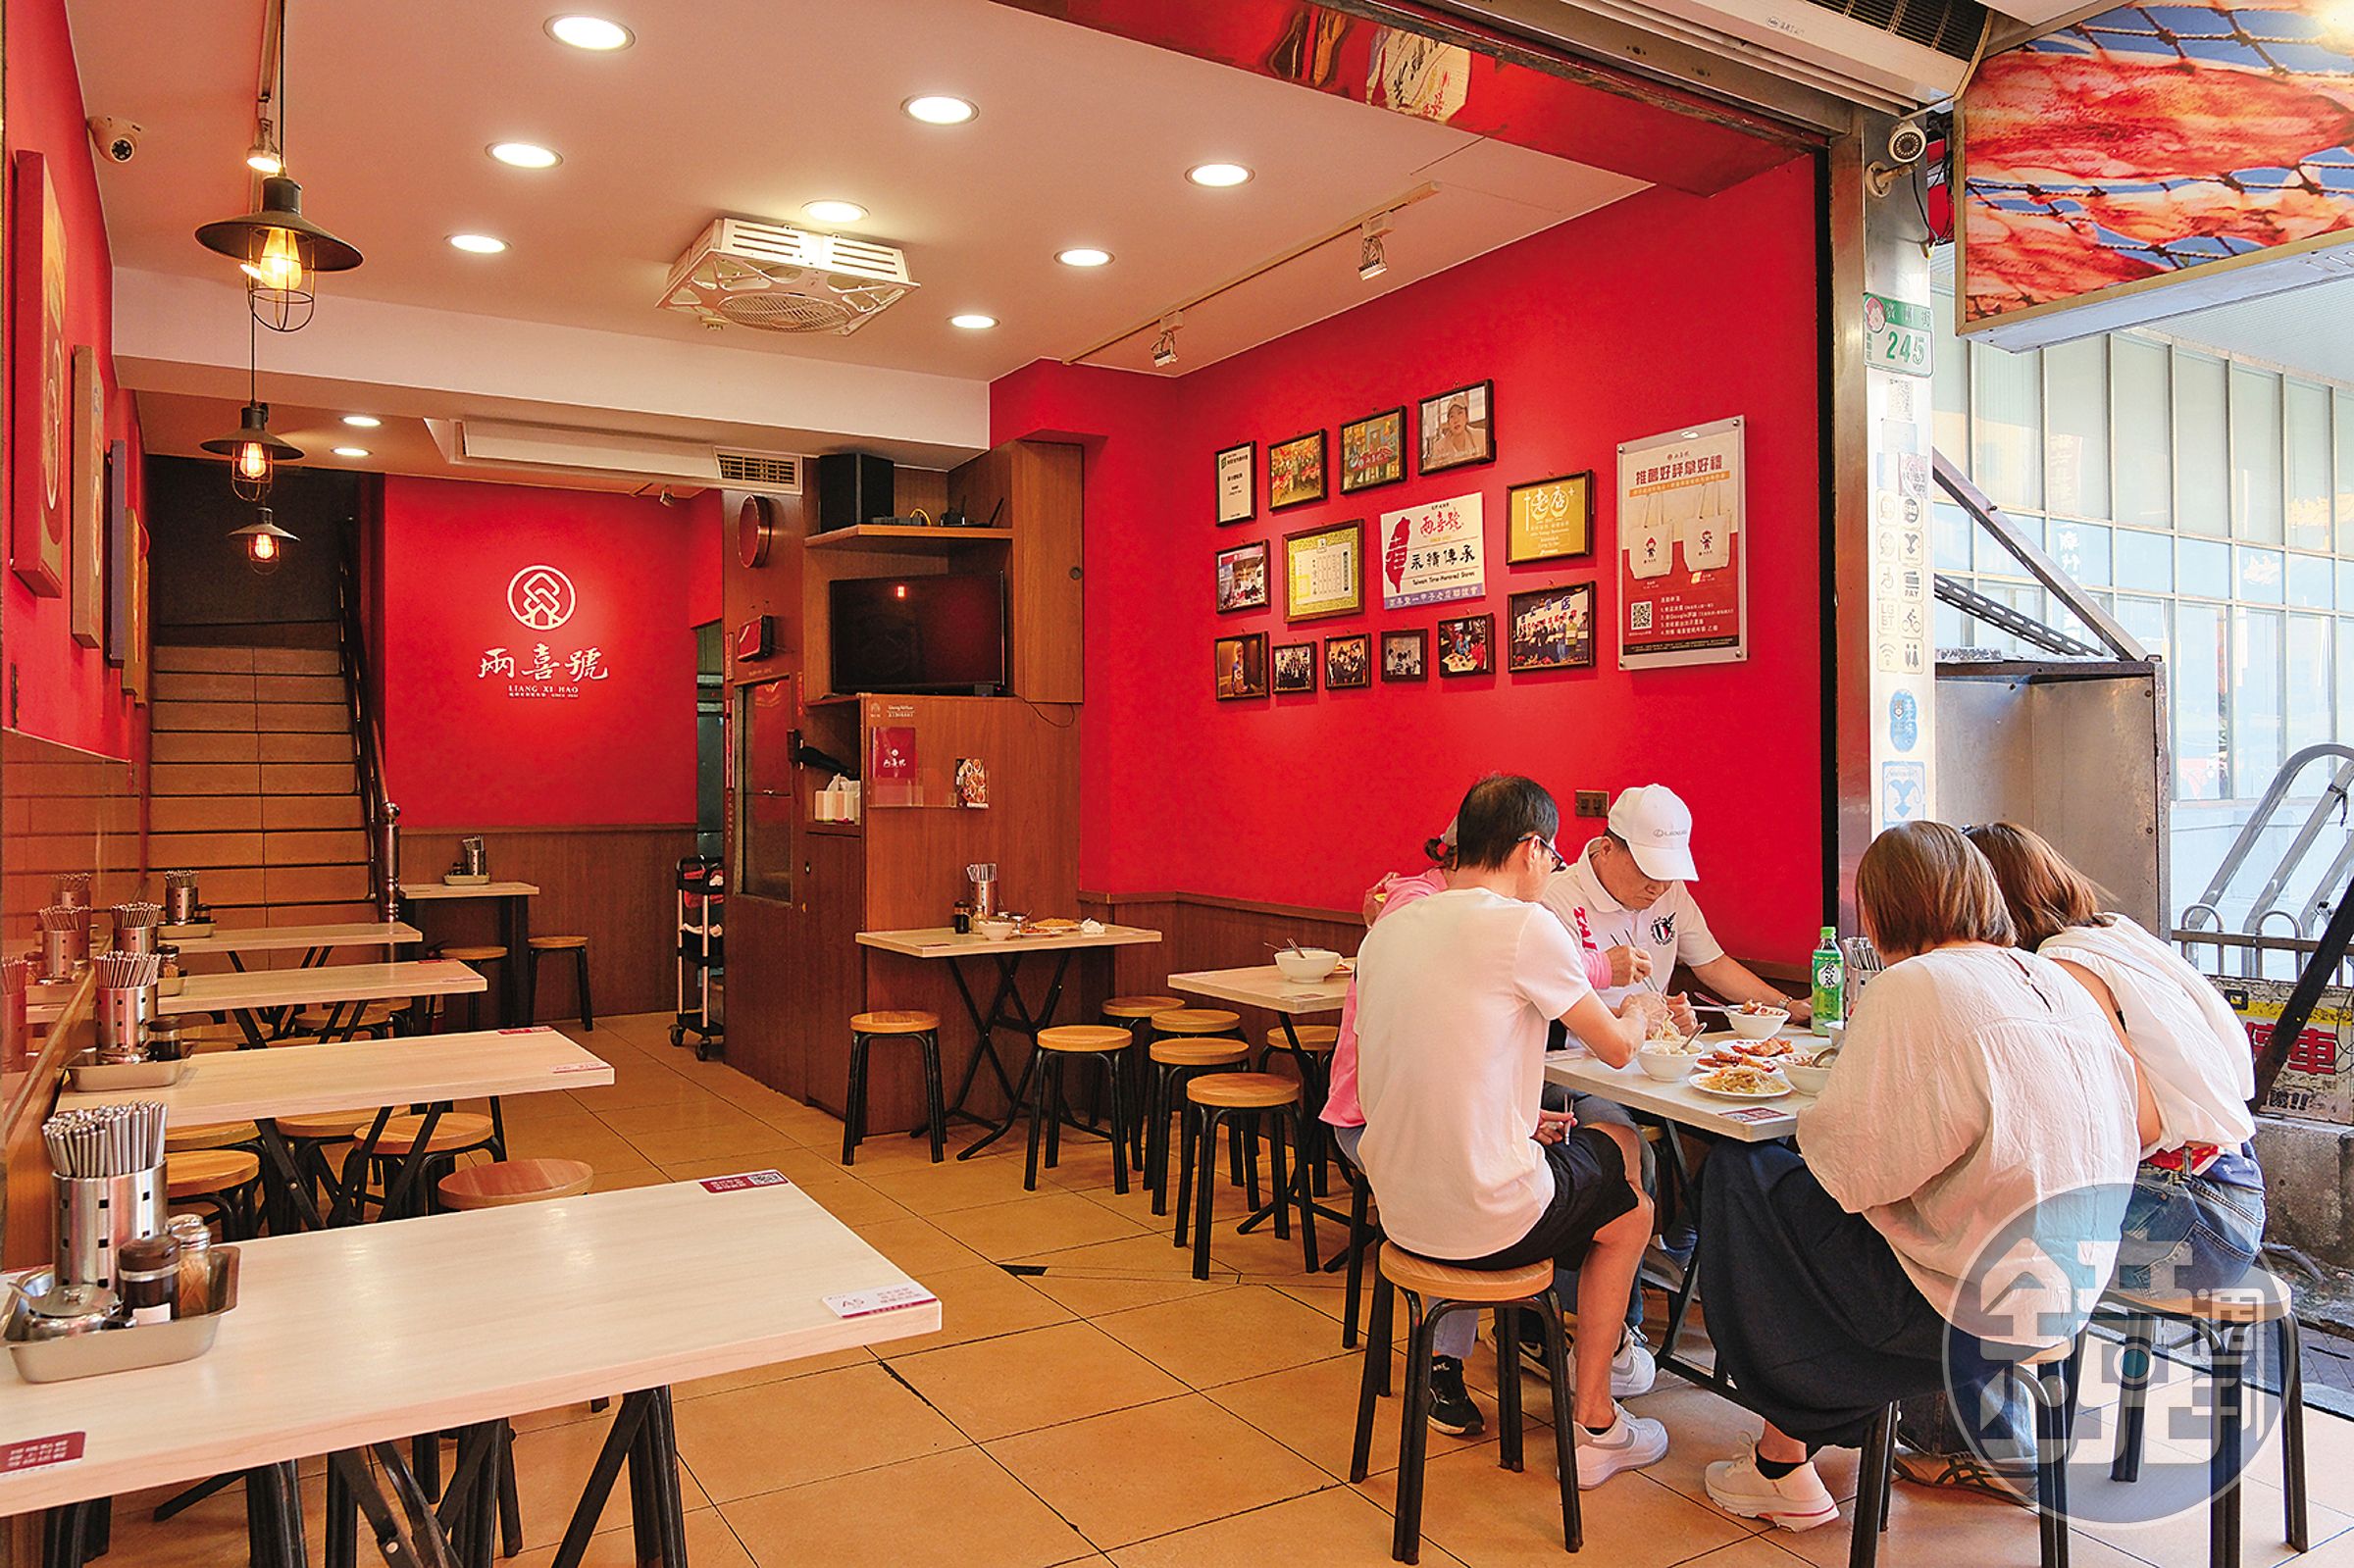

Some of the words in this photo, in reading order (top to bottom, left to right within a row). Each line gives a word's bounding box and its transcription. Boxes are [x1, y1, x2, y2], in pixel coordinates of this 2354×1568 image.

[1886, 330, 1924, 366] 245
[478, 643, 609, 683] 兩喜號
[508, 684, 538, 693] LIANG
